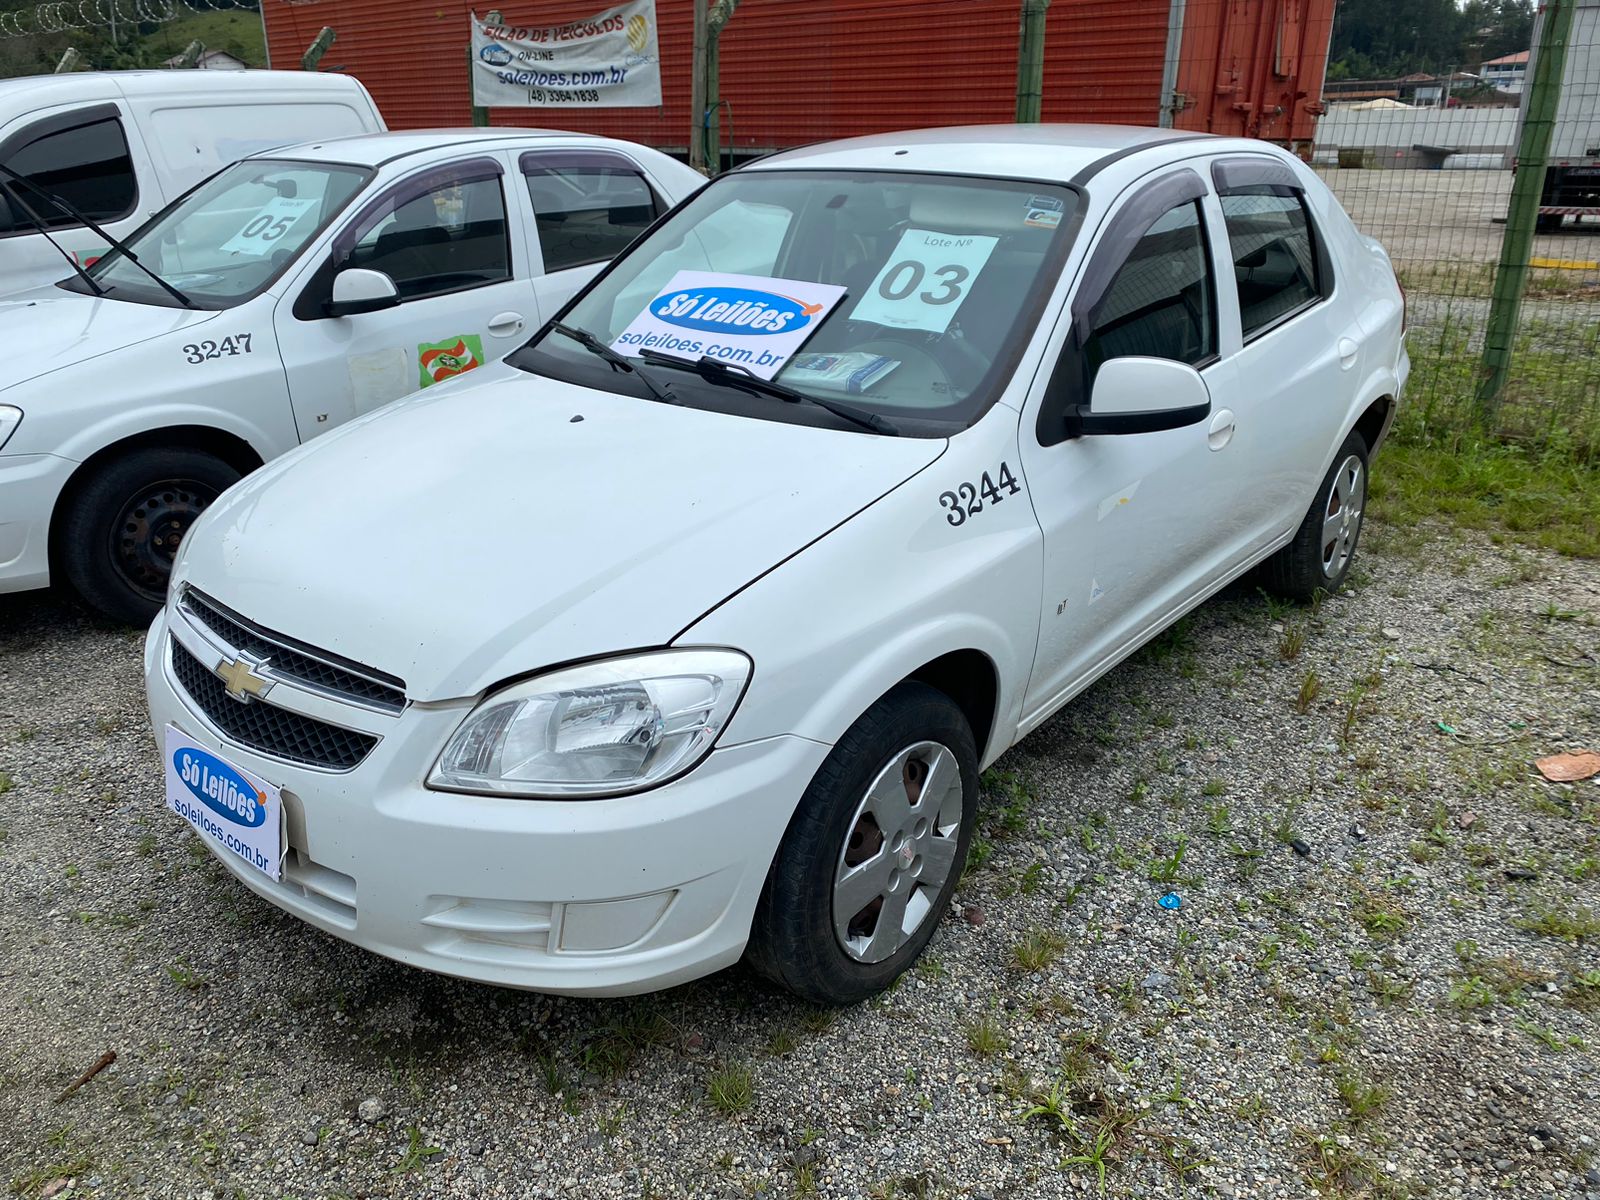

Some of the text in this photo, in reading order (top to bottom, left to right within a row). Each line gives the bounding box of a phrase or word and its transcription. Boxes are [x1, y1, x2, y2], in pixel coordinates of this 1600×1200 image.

[530, 29, 549, 42] DE
[496, 66, 628, 86] soleiloes.com.br
[528, 89, 599, 104] (48) 3364.1838
[242, 214, 297, 241] 05
[924, 236, 952, 247] Lote
[878, 260, 970, 305] 03
[656, 293, 796, 332] Só Leilões
[182, 333, 252, 364] 3247
[618, 331, 785, 367] soleiloes.com.br
[938, 461, 1021, 527] 3244
[181, 753, 257, 823] Só Leilões
[174, 799, 269, 871] soleiloes.com.br
